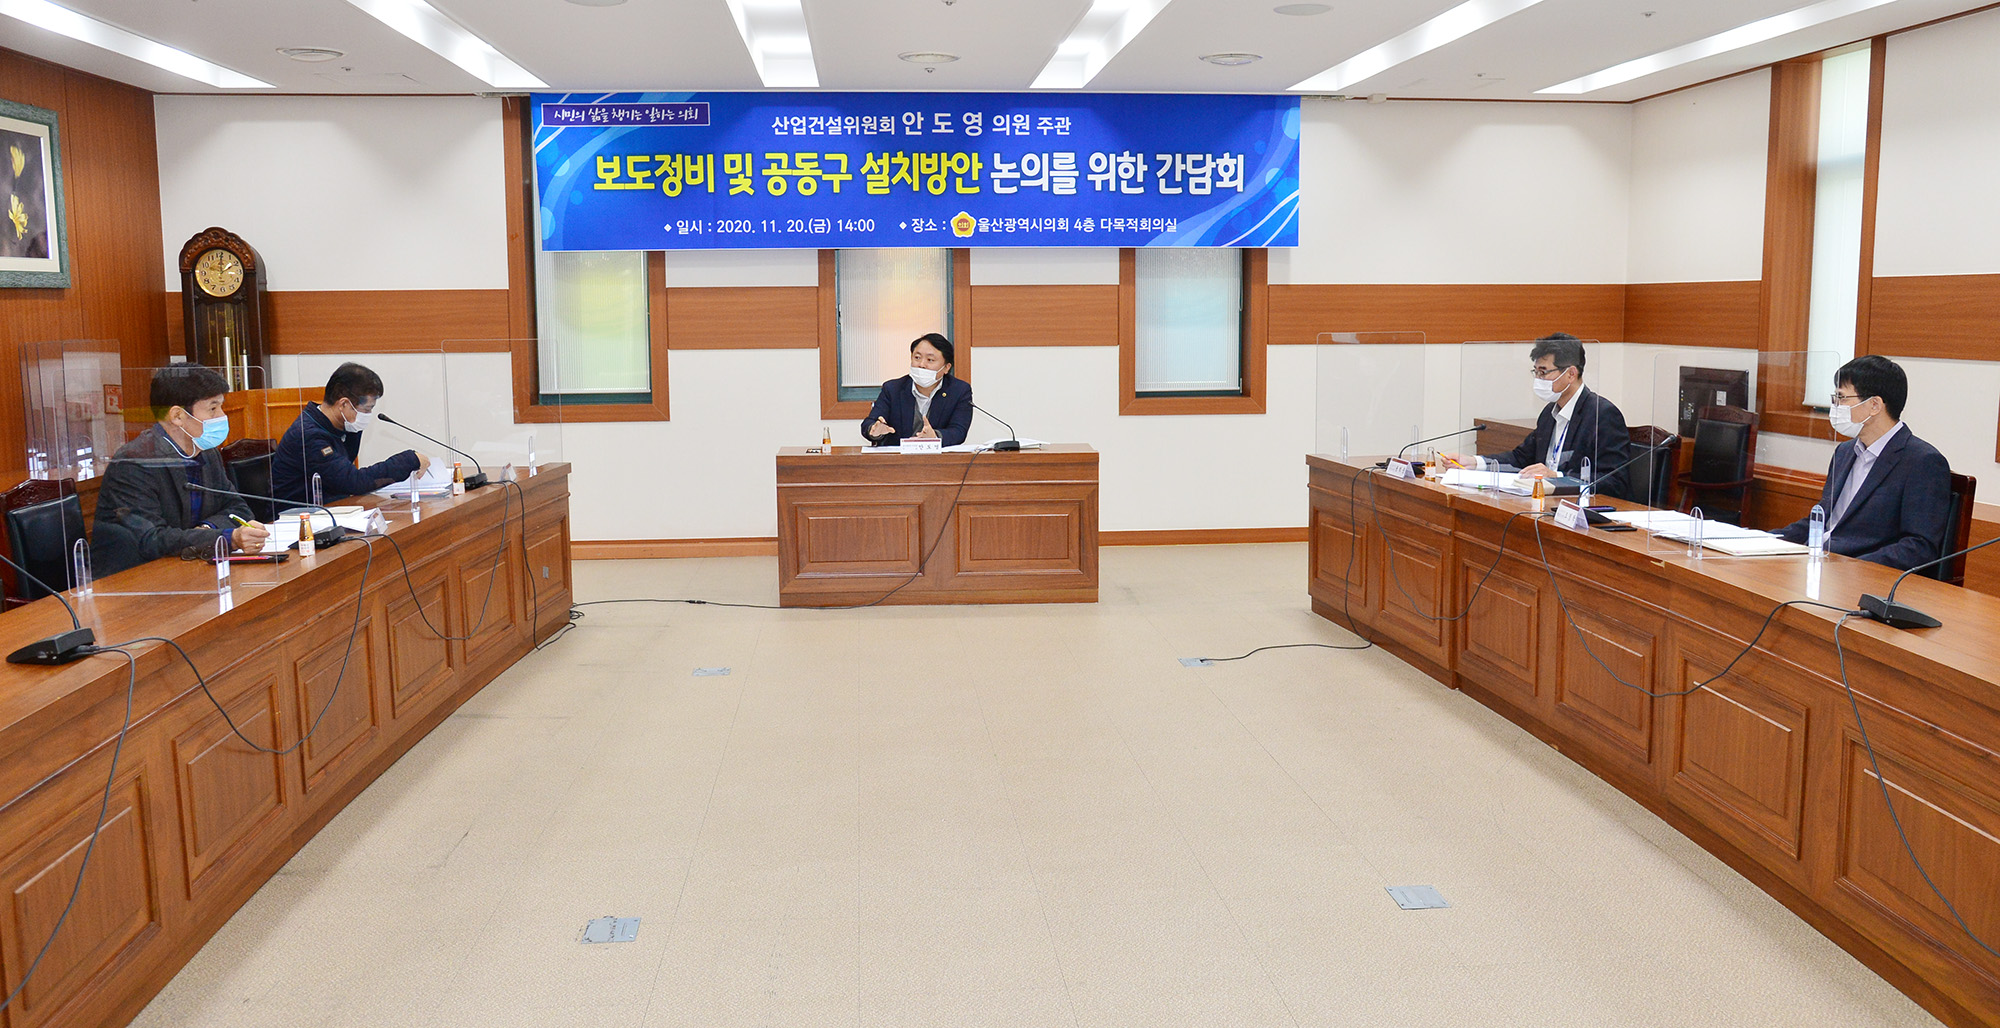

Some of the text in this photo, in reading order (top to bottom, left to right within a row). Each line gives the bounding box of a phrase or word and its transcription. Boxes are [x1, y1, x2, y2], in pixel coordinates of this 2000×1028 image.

[554, 106, 699, 123] 시민의 삶을 챙기는 일하는 의회
[771, 111, 1071, 136] 산업건설위원회 안 도 영 의원 주관
[593, 150, 1245, 198] 보도정비 및 공동구 설치방안 논의를 위한 간담회
[676, 219, 703, 235] 일시
[716, 219, 756, 234] 2020.
[760, 219, 782, 234] 11.
[786, 218, 832, 235] 20.(금)
[836, 218, 876, 233] 14:00
[910, 217, 938, 233] 장소
[977, 216, 1069, 233] 울산광역시의회
[1073, 217, 1096, 233] 4층
[1100, 217, 1177, 233] 다목적회의실
